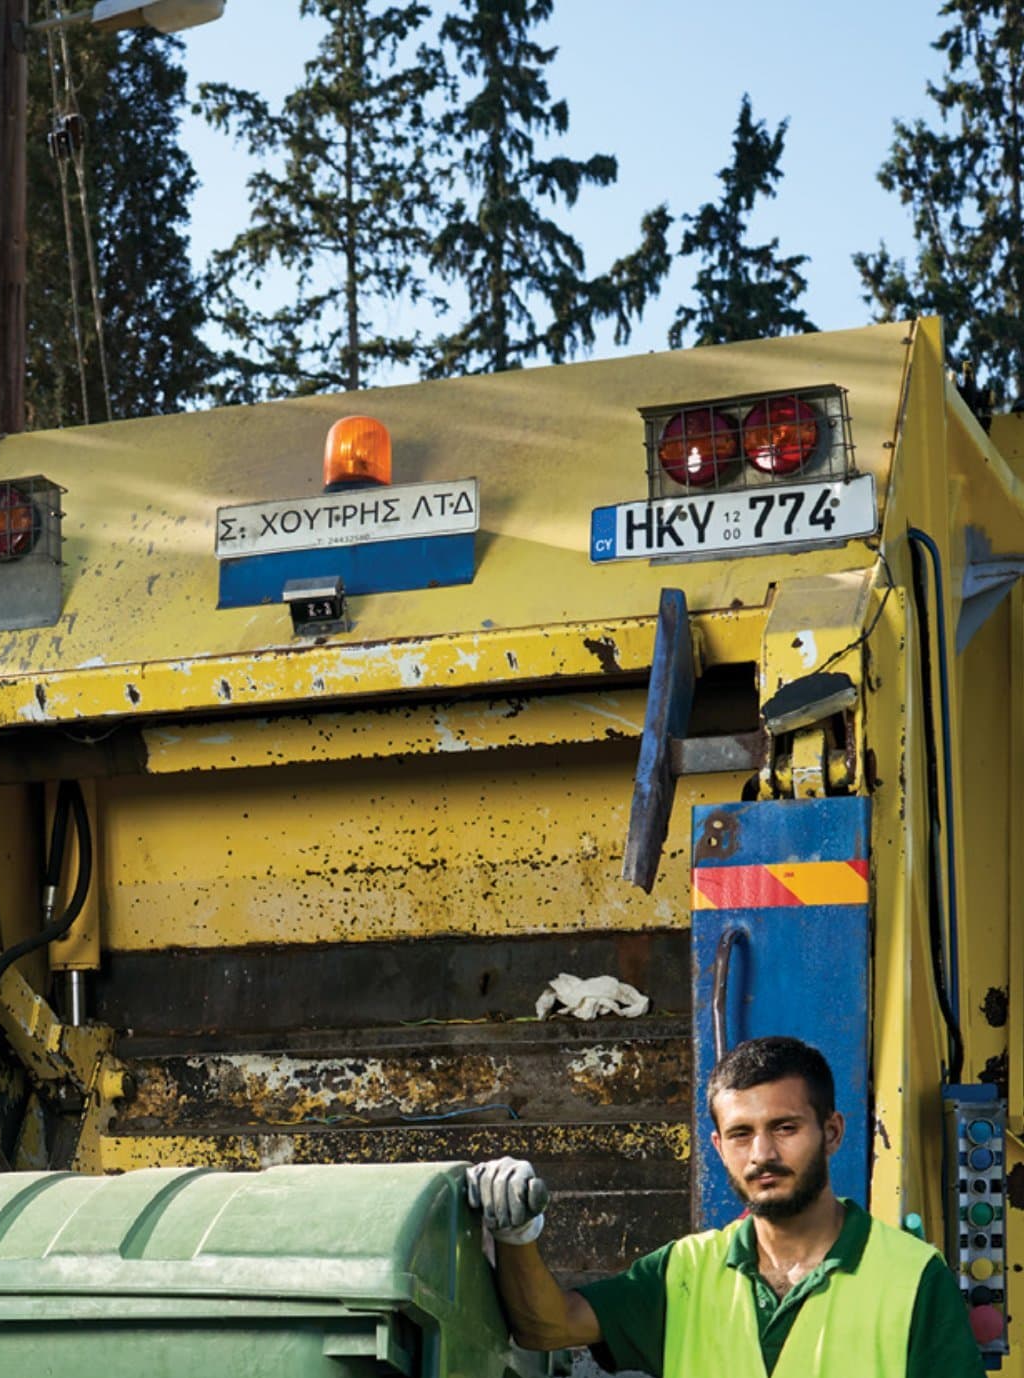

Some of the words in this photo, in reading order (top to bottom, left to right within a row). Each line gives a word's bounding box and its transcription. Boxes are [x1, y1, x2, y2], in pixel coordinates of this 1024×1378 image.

[260, 498, 400, 537] ΧΟΥΤΡΗΣ
[625, 500, 715, 550] HKY
[749, 488, 836, 538] 774
[723, 510, 742, 523] 12
[722, 528, 742, 541] 00
[595, 538, 614, 552] CY
